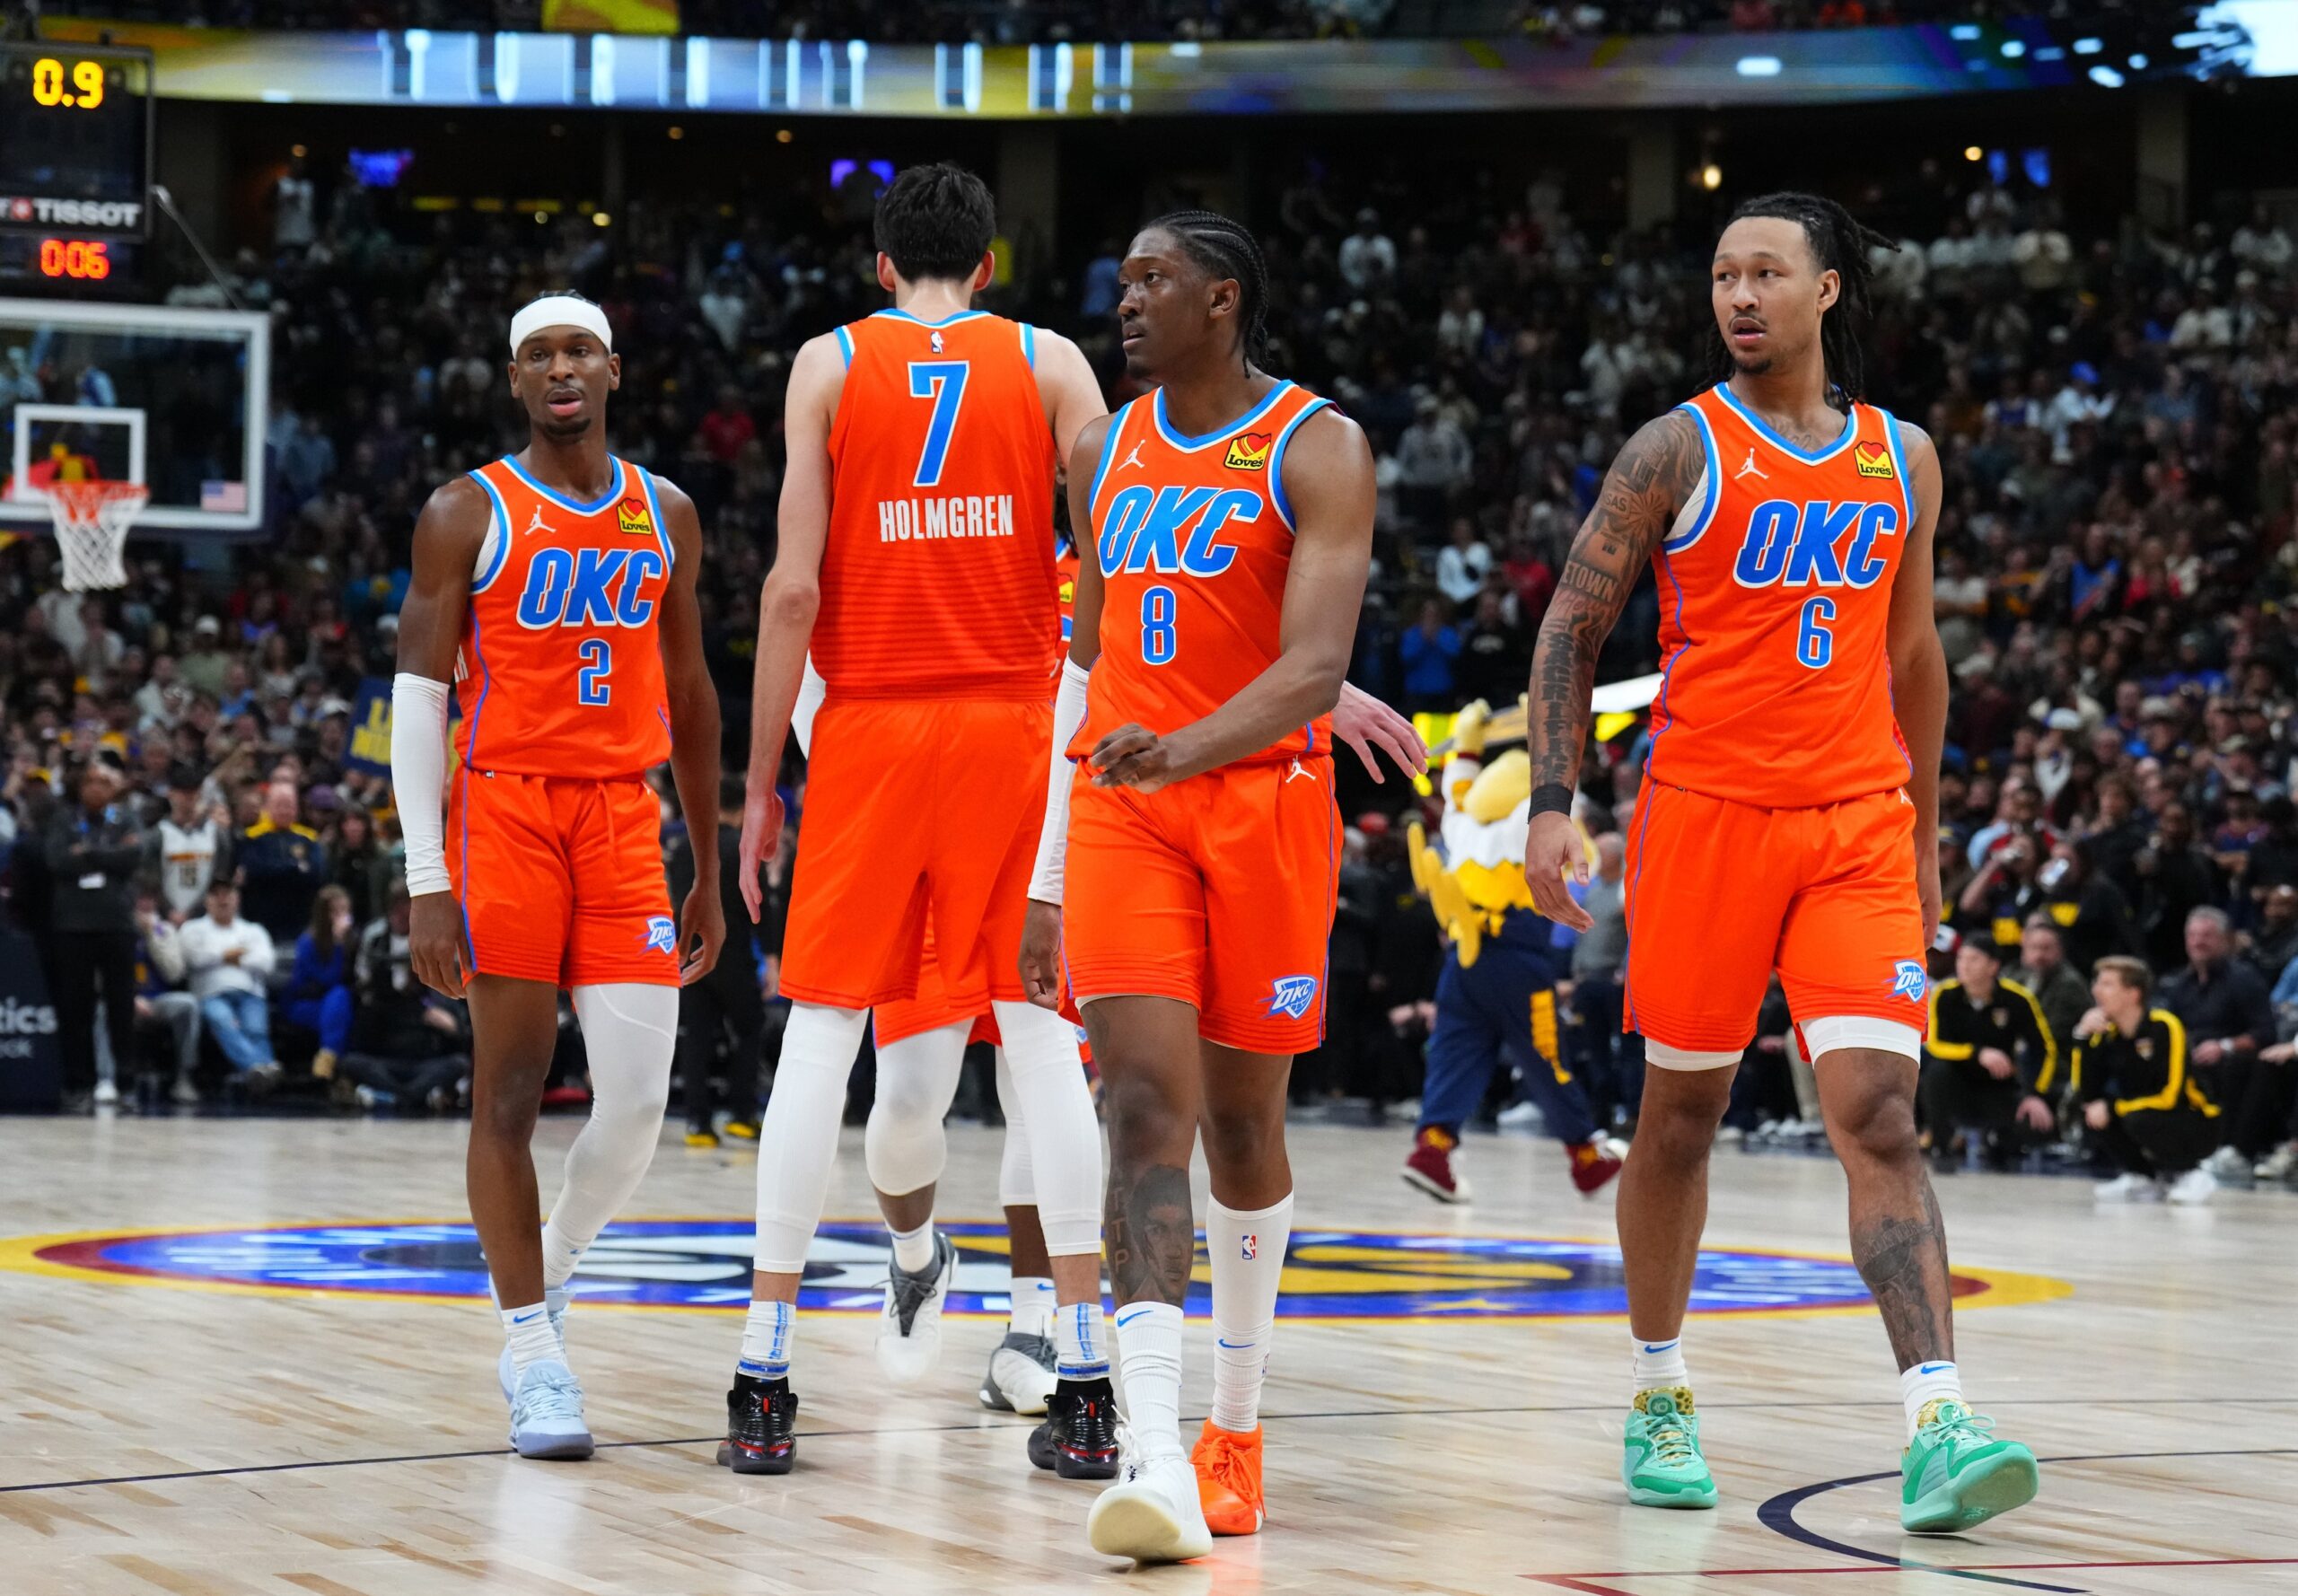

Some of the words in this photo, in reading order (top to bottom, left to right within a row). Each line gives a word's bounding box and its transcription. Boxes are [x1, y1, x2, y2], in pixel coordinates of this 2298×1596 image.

[33, 58, 103, 109] 0.9
[33, 197, 142, 227] TISSOT
[907, 360, 969, 487] 7
[878, 495, 1013, 542] HOLMGREN
[1099, 484, 1264, 579] OKC
[1732, 498, 1899, 590] OKC
[516, 547, 662, 630] OKC
[1141, 584, 1177, 666] 8
[1796, 595, 1837, 669] 6
[578, 637, 611, 706] 2
[1271, 982, 1311, 1011] OKC
